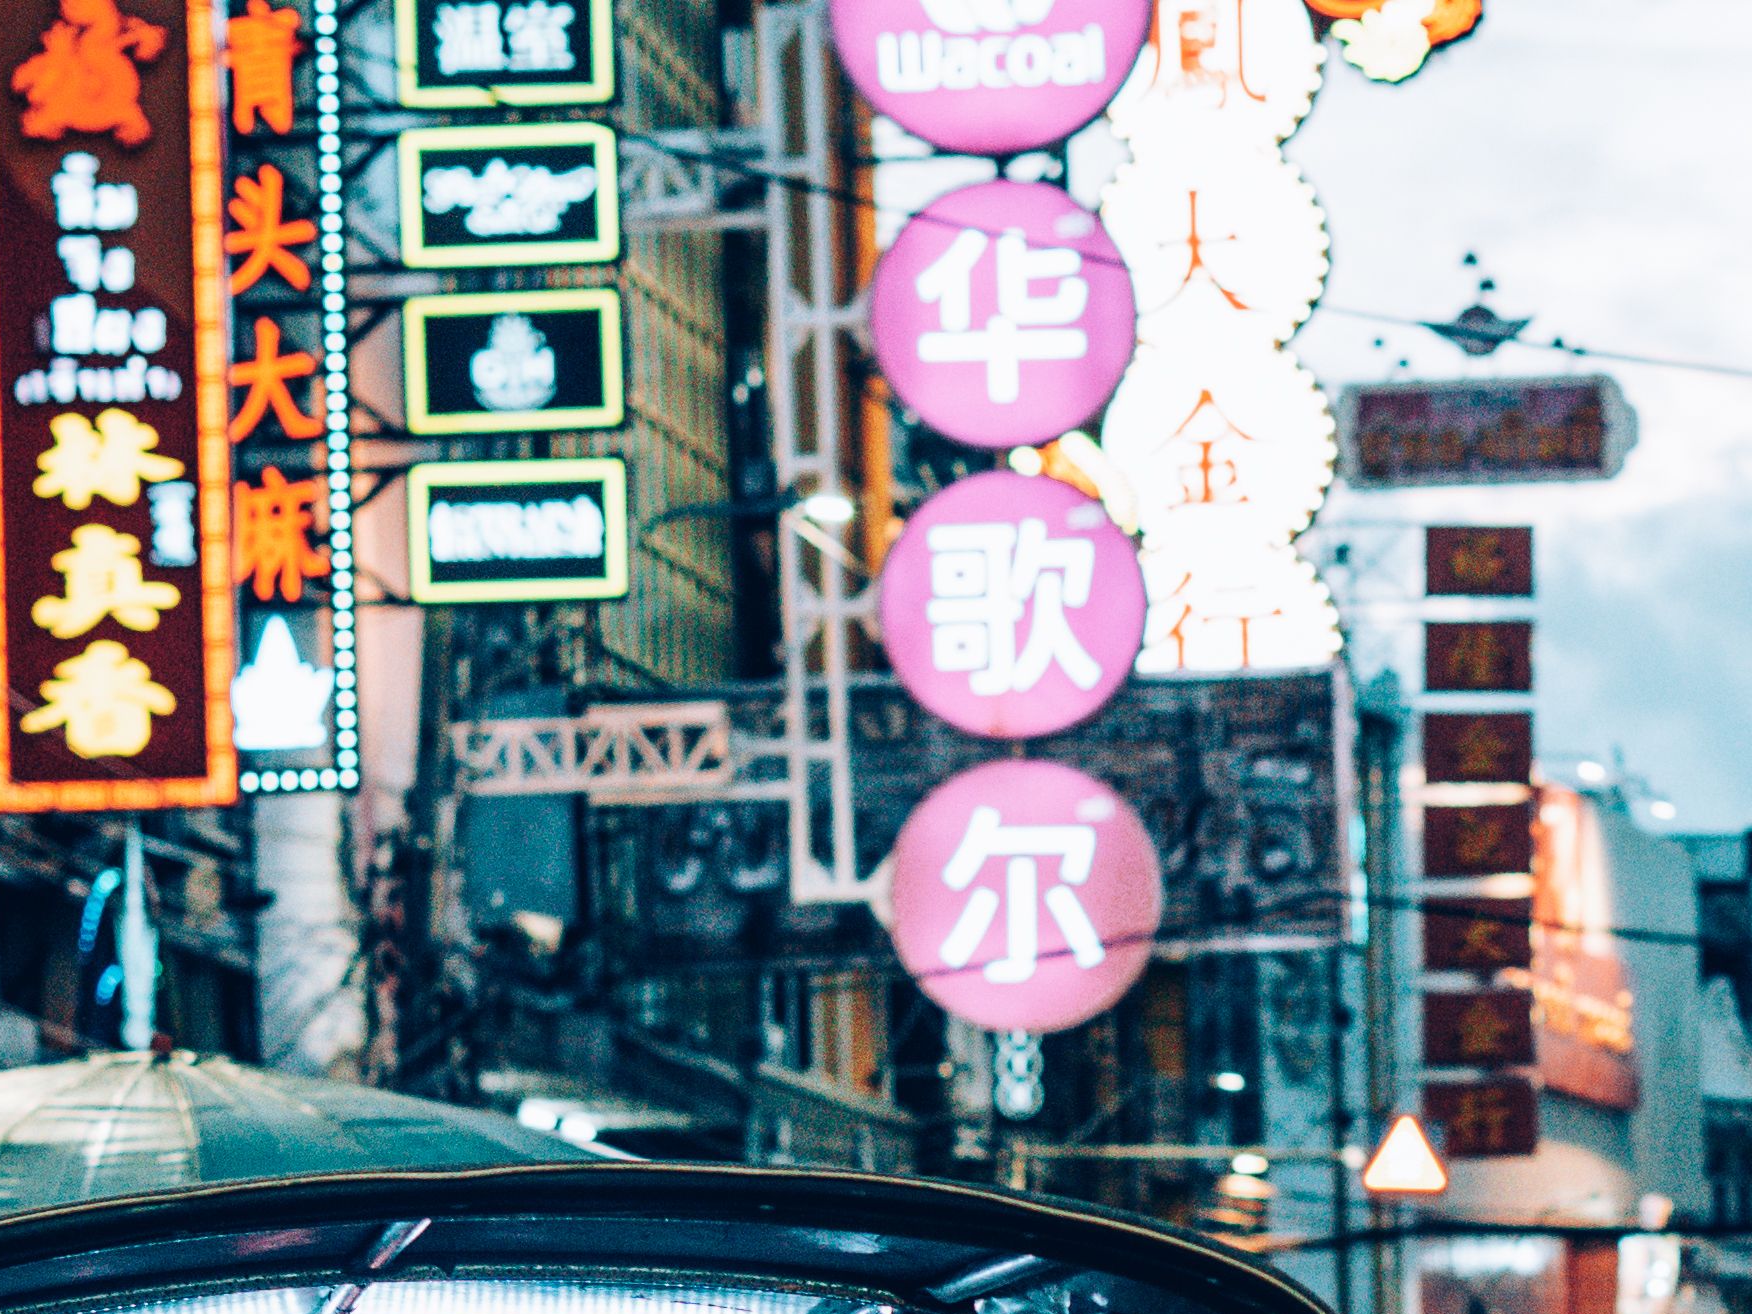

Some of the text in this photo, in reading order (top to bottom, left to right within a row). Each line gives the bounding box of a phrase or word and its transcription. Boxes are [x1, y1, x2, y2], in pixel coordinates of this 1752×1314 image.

[875, 23, 1107, 94] Wacoal
[915, 227, 1106, 985] 华歌尔
